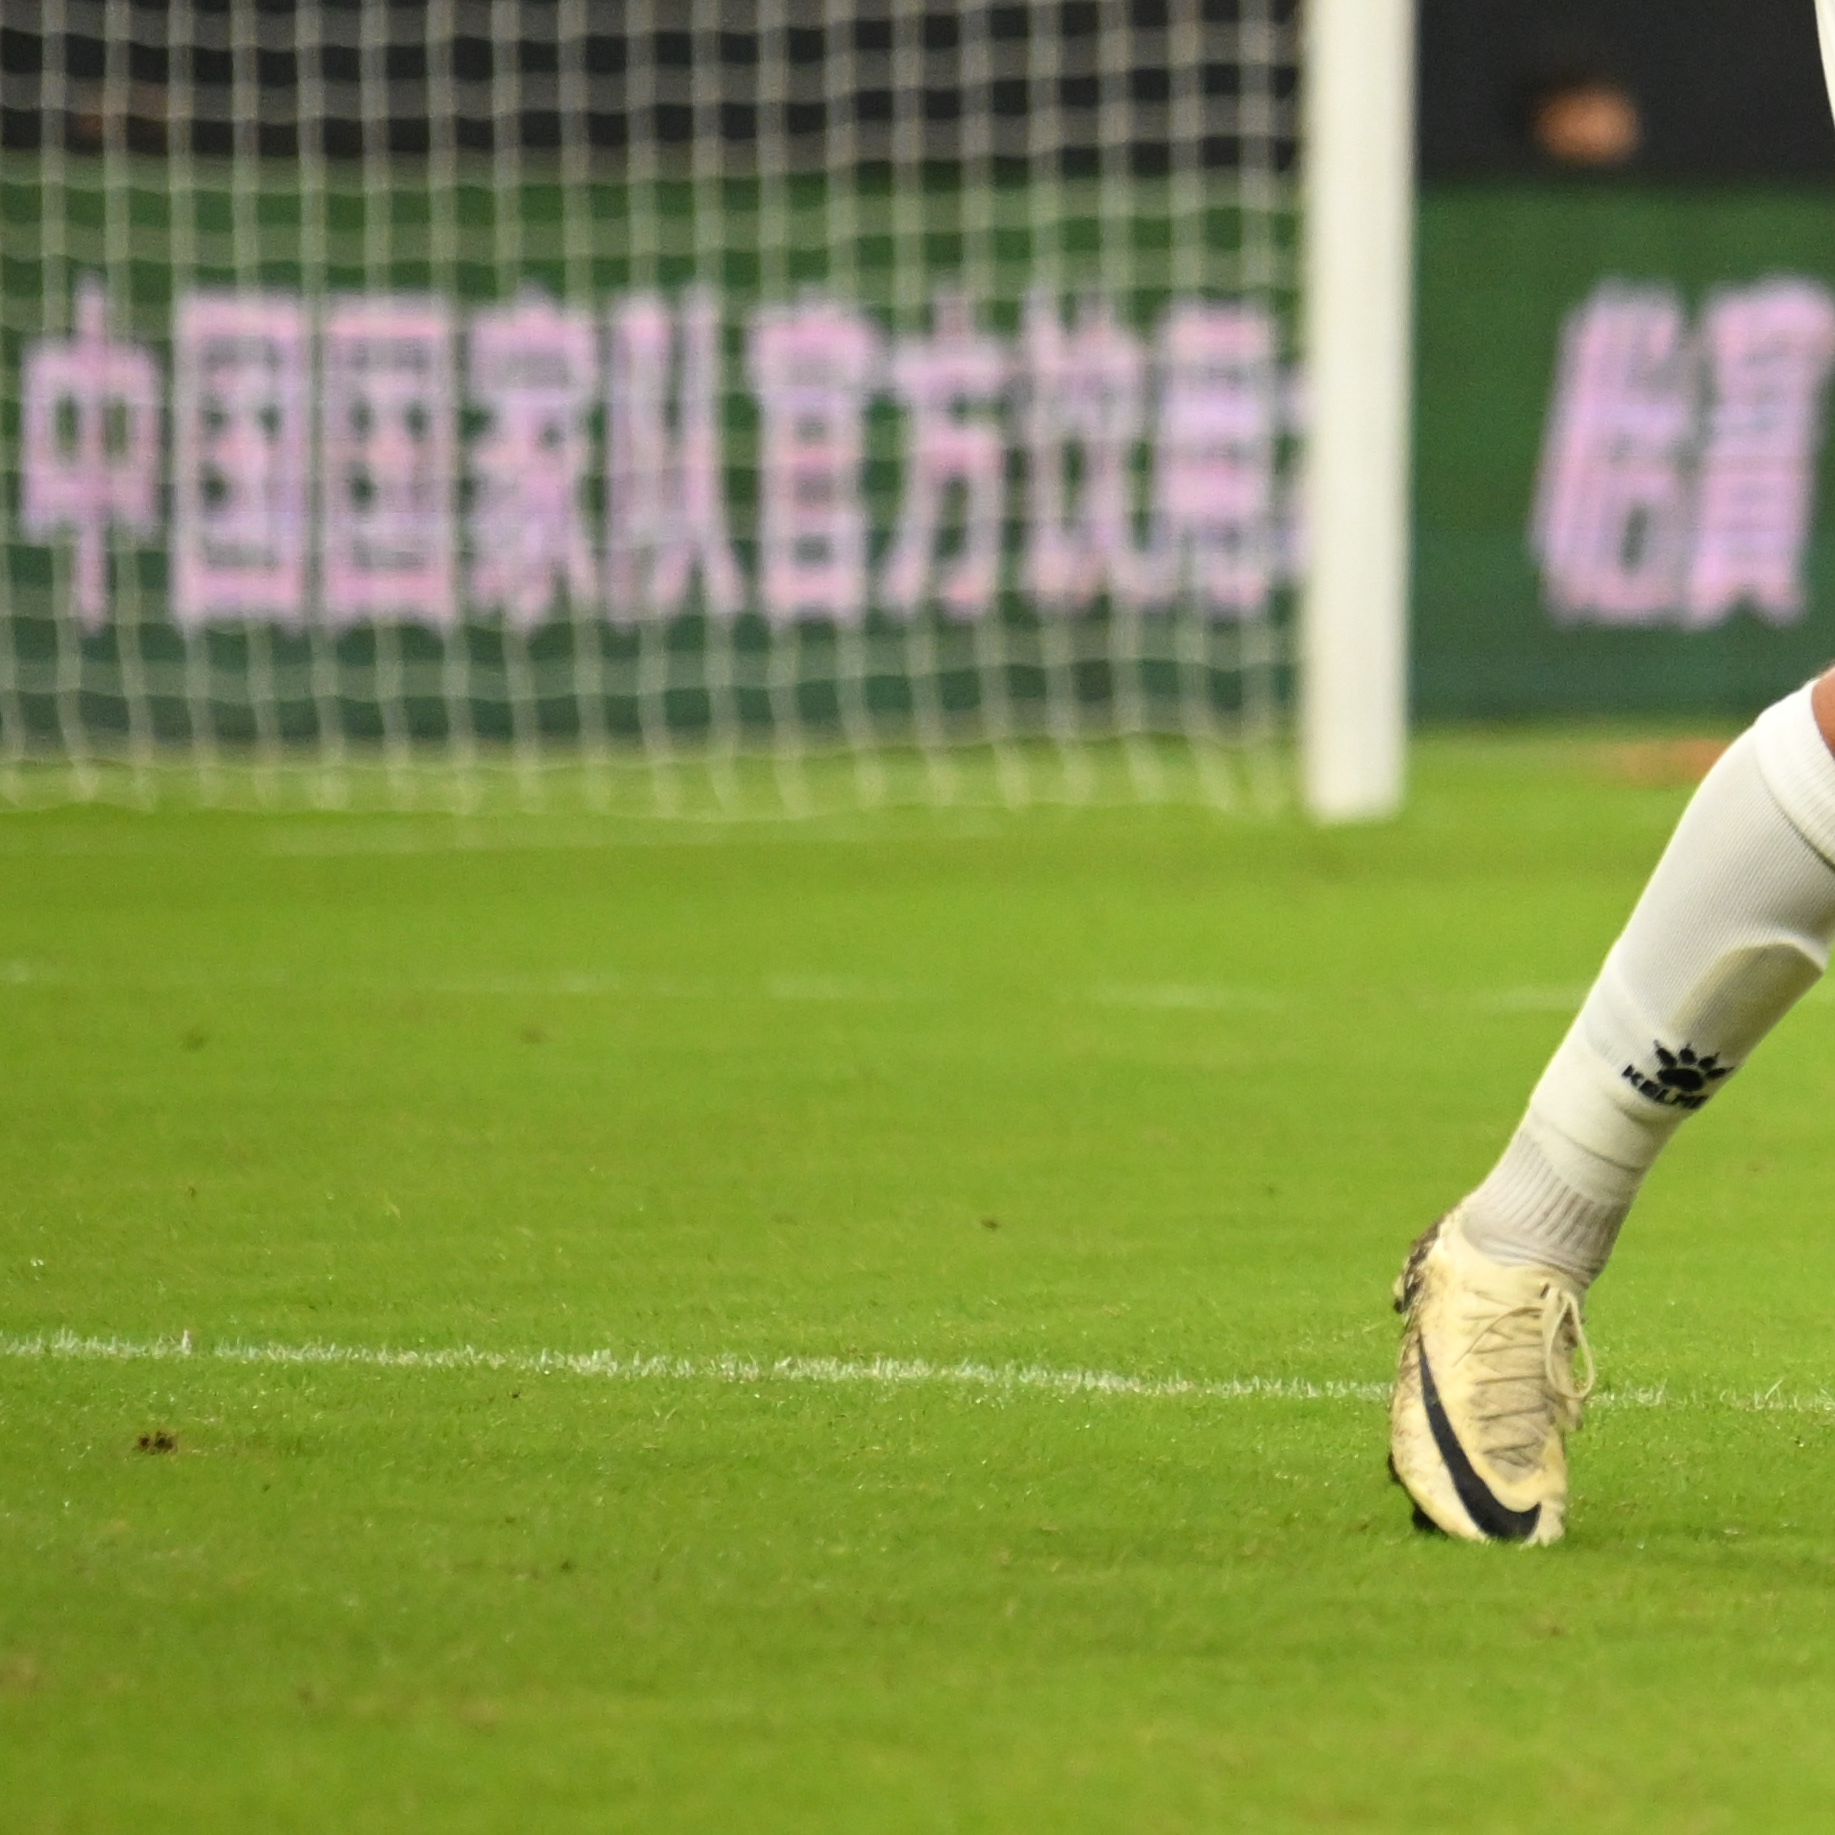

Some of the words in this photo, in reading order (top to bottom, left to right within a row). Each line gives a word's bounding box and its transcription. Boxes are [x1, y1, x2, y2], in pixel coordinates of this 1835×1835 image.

[20, 276, 1312, 628] 中国国家队官方饮用
